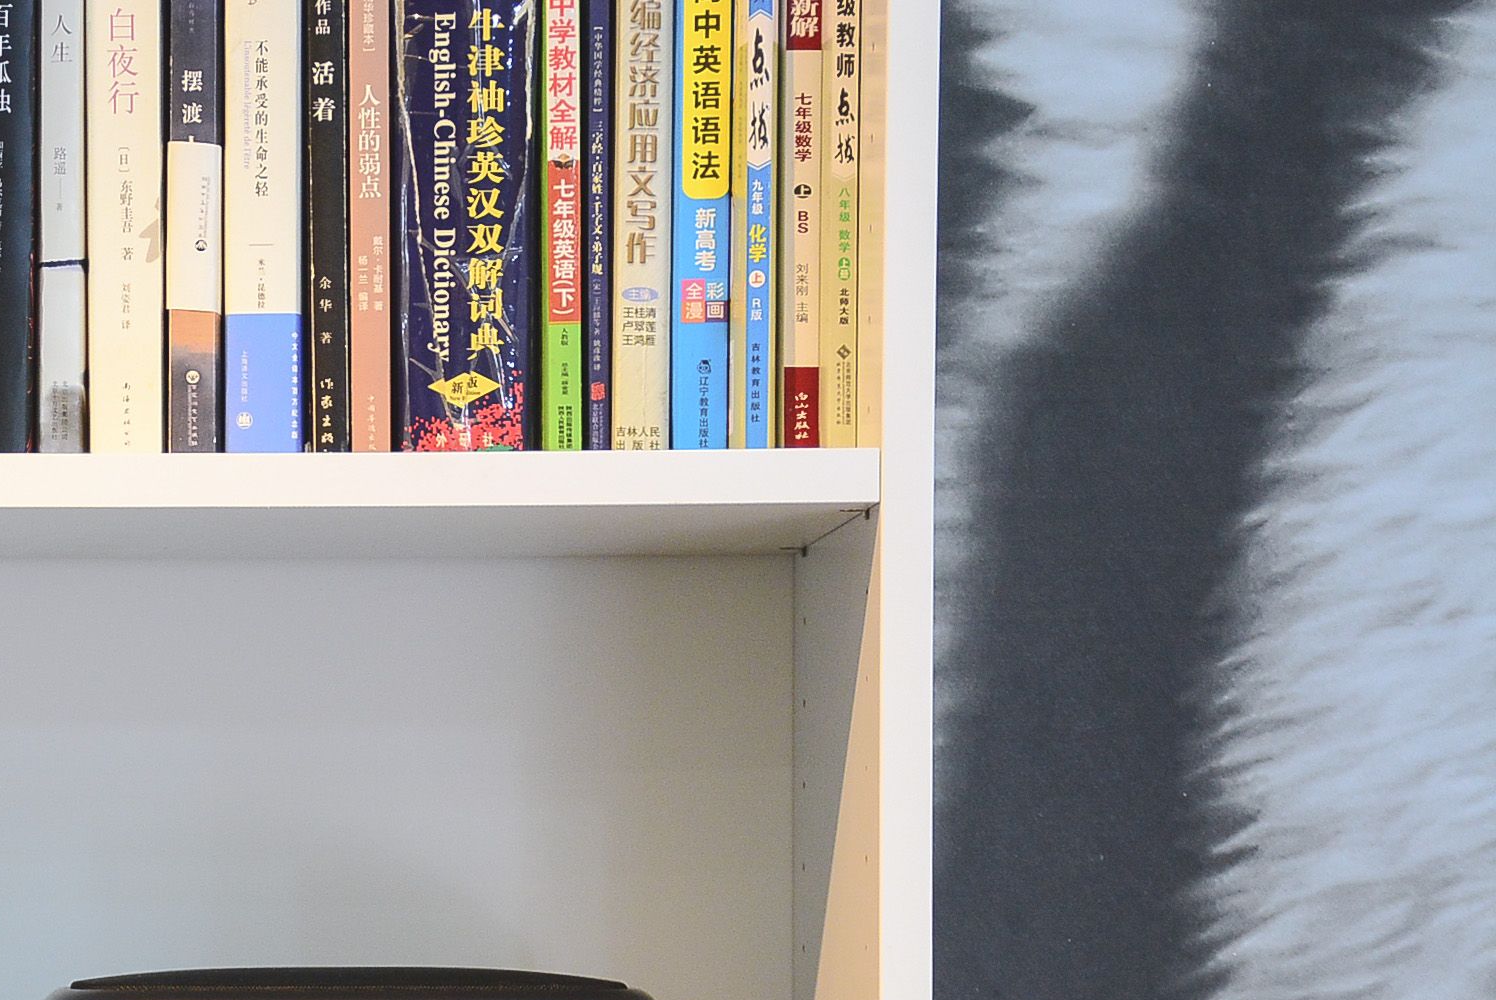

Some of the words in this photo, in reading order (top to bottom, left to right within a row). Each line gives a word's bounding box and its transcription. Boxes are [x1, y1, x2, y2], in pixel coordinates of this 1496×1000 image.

[51, 15, 72, 63] 人生
[107, 8, 139, 115] 白夜行
[836, 0, 856, 78] 级教师
[181, 70, 203, 143] 摆渡
[255, 39, 269, 198] 不能承受的生命之轻
[312, 61, 336, 122] 活着
[429, 12, 457, 220] English-Chinese
[692, 0, 721, 180] 中英语语法
[748, 27, 770, 150] 点拨
[358, 84, 381, 198] 人性的弱点
[625, 0, 662, 264] 编经济应用文写作
[795, 92, 812, 162] 七年级数学
[54, 147, 66, 176] 路遥
[466, 8, 505, 361] 牛津袖珍英汉双解词典
[119, 180, 134, 233] 东野圭吾
[751, 179, 764, 215] 九年级
[798, 211, 809, 233] BS
[839, 187, 851, 222] 八年级
[552, 179, 576, 315] 七年级英语(下)
[694, 207, 717, 272] 新高考
[749, 224, 767, 263] 化学
[839, 229, 851, 253] 数学
[319, 276, 333, 313] 余华
[428, 227, 457, 362] Dictionary
[796, 263, 809, 296] 刘来刚
[839, 287, 850, 325] 北师大版
[622, 306, 657, 319] 王桂清
[796, 302, 809, 324] 主编
[451, 376, 479, 396] 新版
[698, 377, 709, 448] 辽宁教育出版社
[750, 343, 761, 423] 吉林教育出版社
[319, 378, 335, 452] 作家出版
[616, 426, 660, 438] 吉林人民
[616, 440, 660, 452] 出版社
